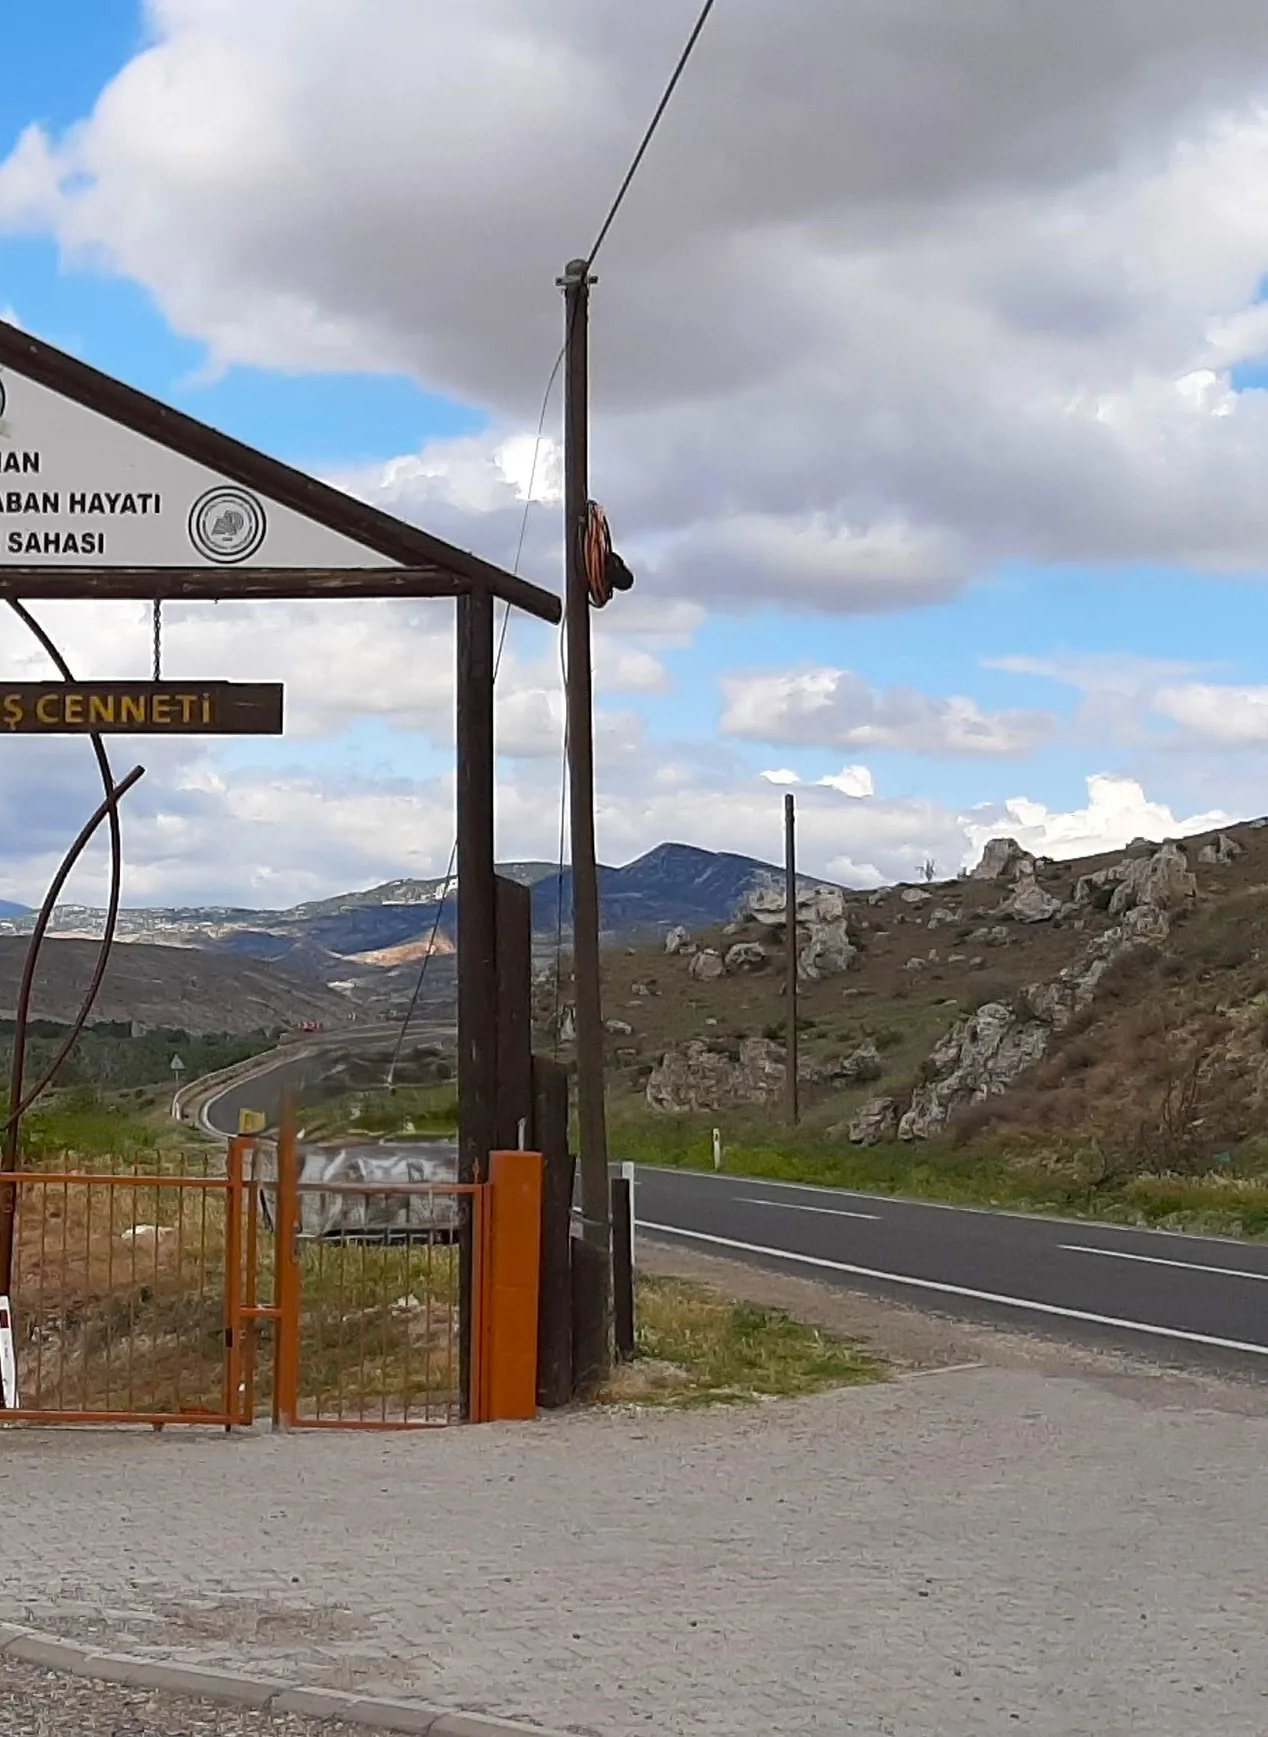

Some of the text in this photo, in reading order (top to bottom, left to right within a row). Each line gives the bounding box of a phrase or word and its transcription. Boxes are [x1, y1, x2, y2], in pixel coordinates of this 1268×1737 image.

[68, 492, 162, 515] HAYATI
[7, 531, 105, 555] SAHASI
[34, 692, 212, 724] CENNETİ
